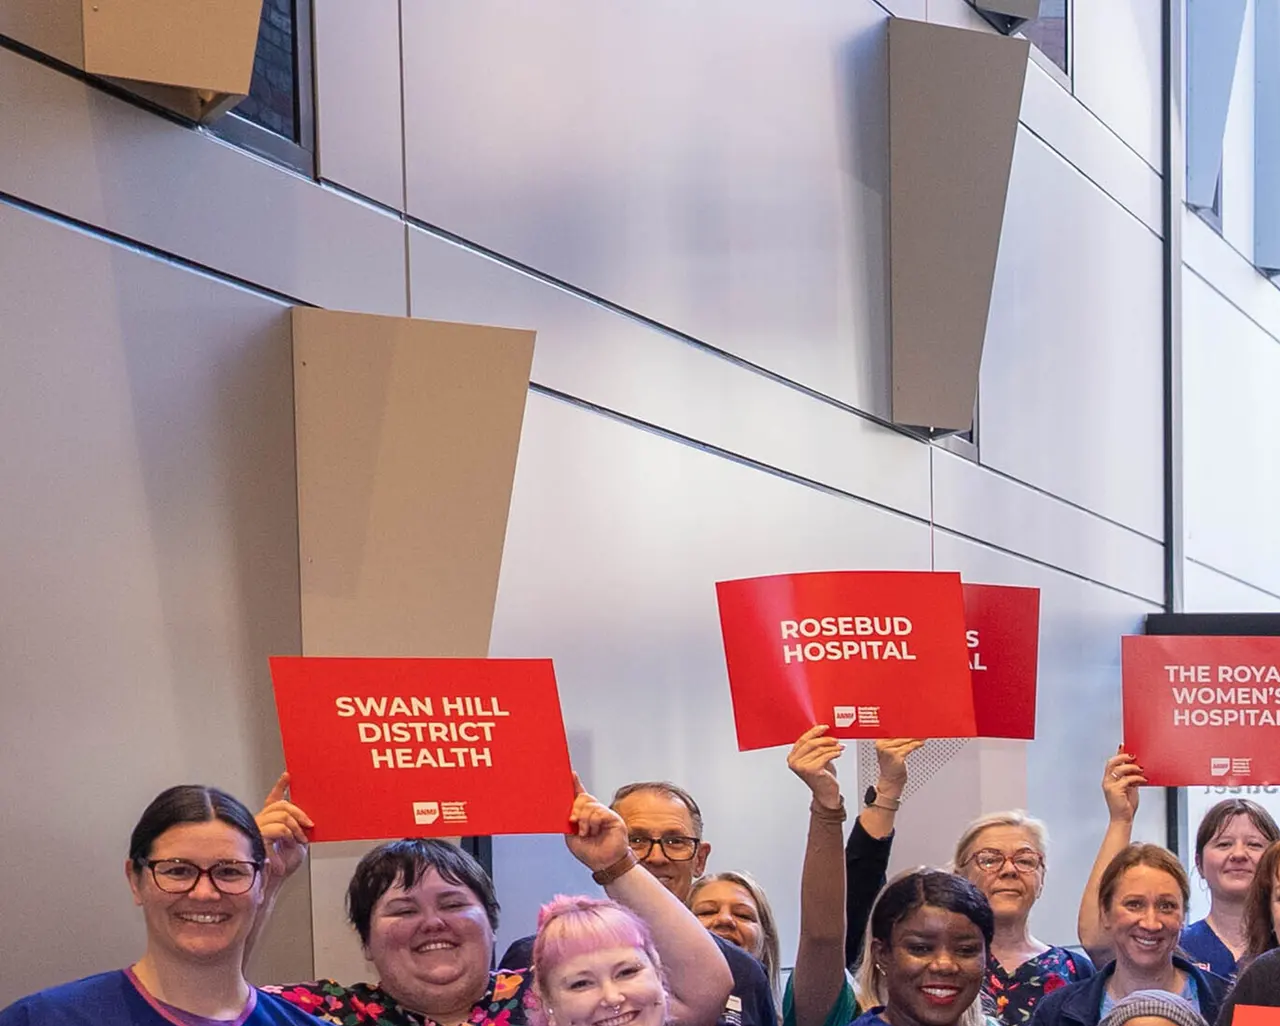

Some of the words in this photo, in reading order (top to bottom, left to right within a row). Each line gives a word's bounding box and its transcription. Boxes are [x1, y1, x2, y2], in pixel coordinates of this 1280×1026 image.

[779, 616, 913, 640] ROSEBUD
[782, 640, 917, 664] HOSPITAL
[1164, 665, 1212, 683] THE
[335, 696, 434, 717] SWAN
[442, 696, 510, 717] HILL
[357, 721, 496, 743] DISTRICT
[371, 747, 493, 769] HEALTH
